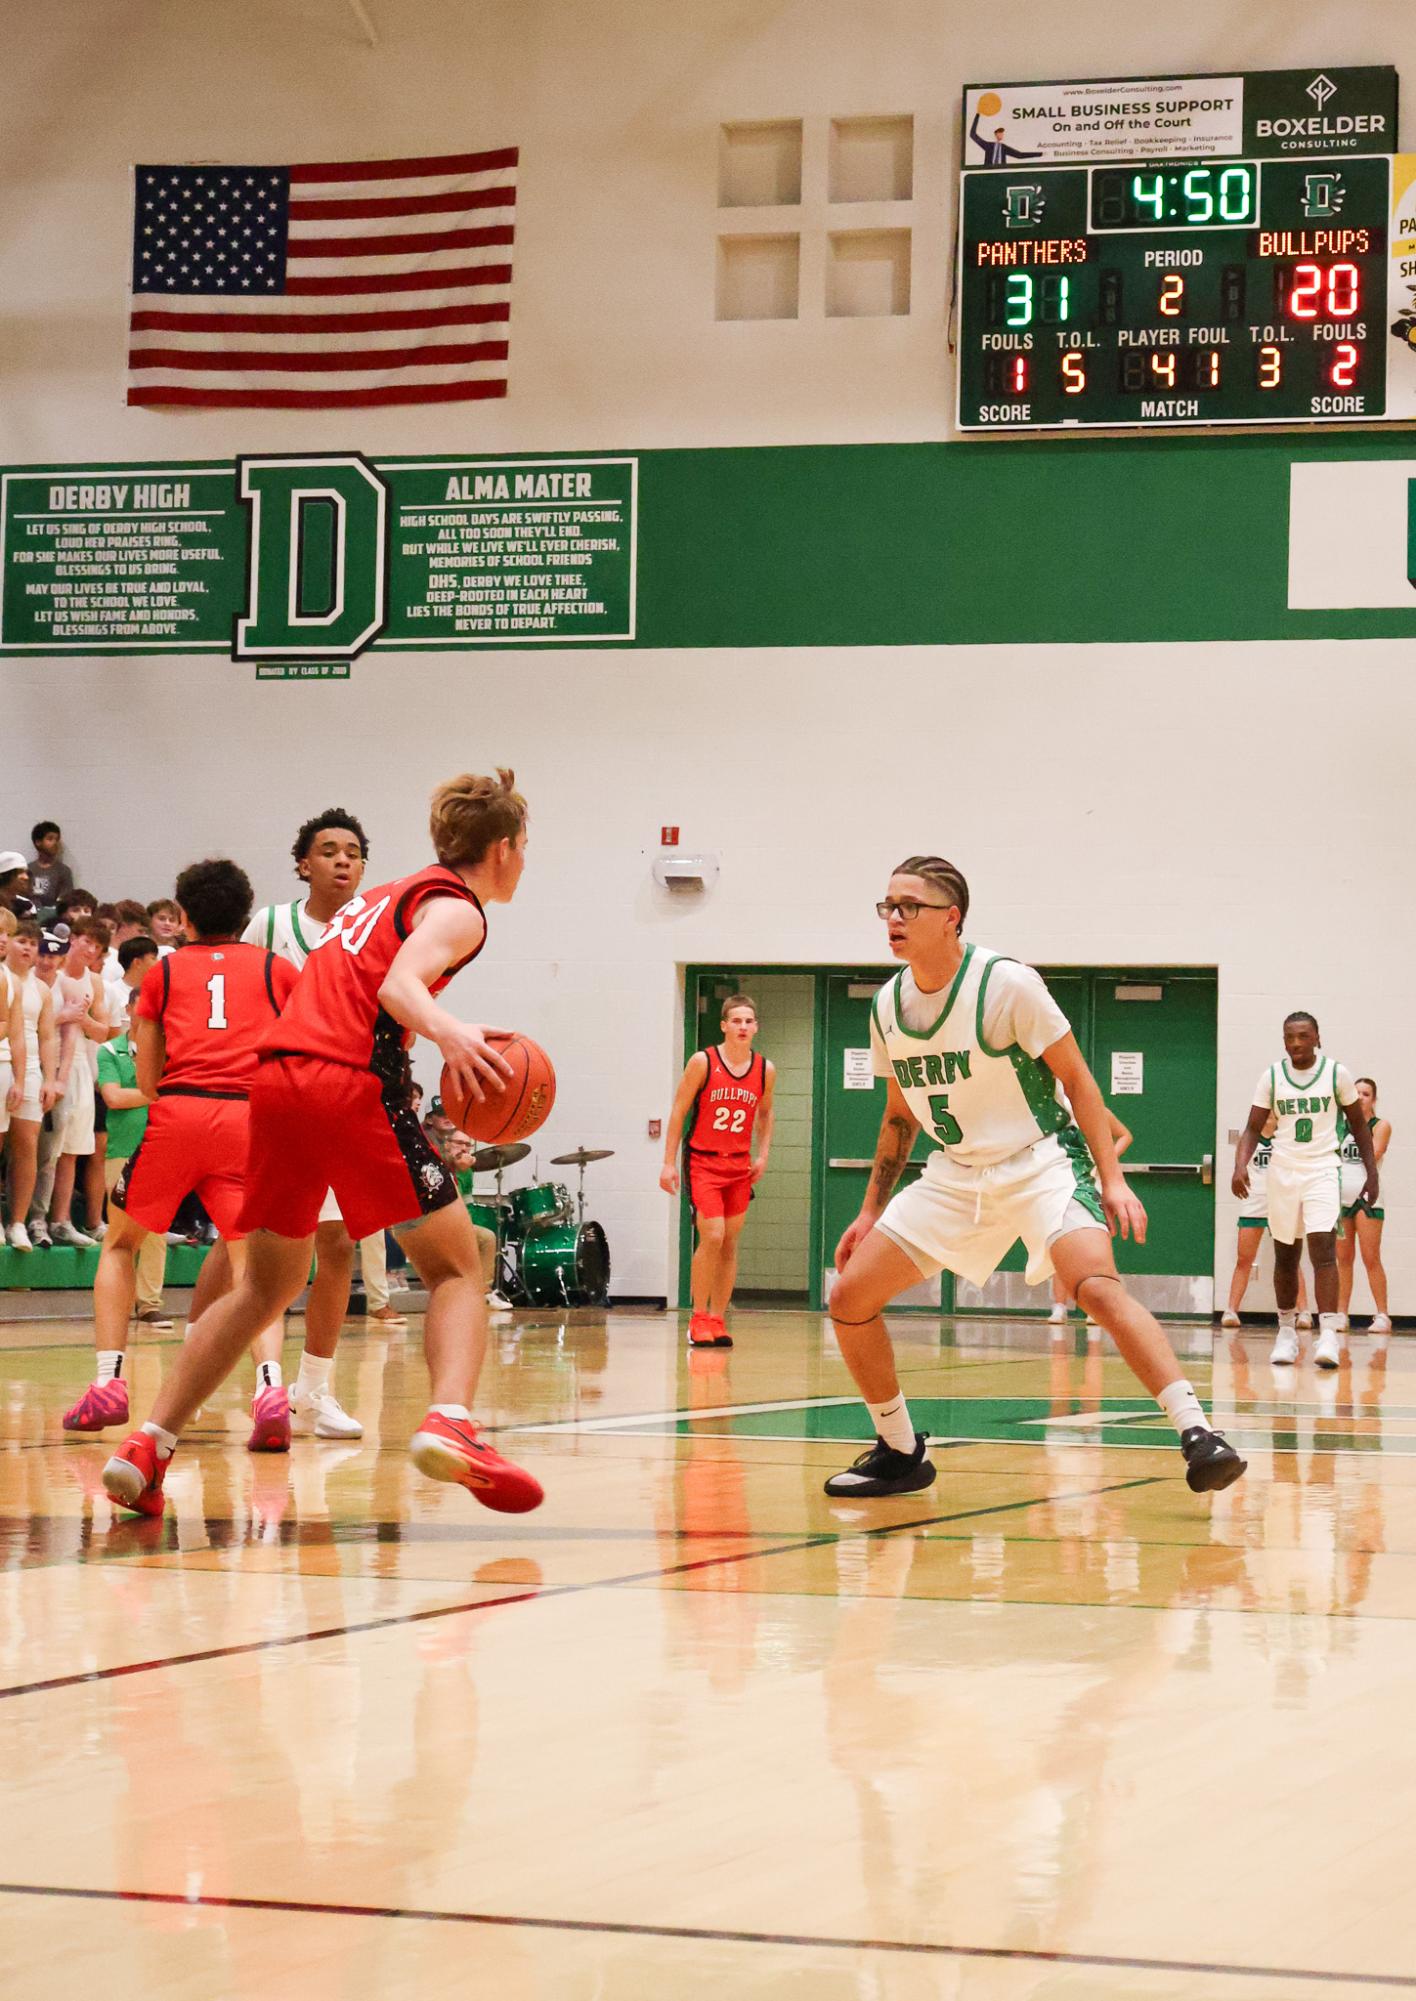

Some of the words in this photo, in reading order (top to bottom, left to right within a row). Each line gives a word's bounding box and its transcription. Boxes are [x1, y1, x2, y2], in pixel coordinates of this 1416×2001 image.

[1012, 106, 1066, 120] SMALL
[1071, 102, 1151, 117] BUSINESS
[1155, 98, 1234, 113] SUPPORT
[1052, 122, 1071, 132] On
[1075, 120, 1100, 131] and
[1104, 120, 1125, 130] Off
[1128, 119, 1150, 129] the
[1154, 117, 1191, 128] Court
[1256, 114, 1386, 137] BOXELDER
[1281, 139, 1357, 149] CONSULTING
[1133, 168, 1250, 222] 4:50
[1259, 229, 1369, 256] BULLPUPS
[978, 239, 1086, 266] PANTHERS
[1144, 250, 1203, 267] PERIOD
[1159, 275, 1184, 315] 2
[1291, 264, 1358, 317] 20
[1057, 331, 1101, 348] T.O.L.
[1118, 329, 1180, 347] PLAYER
[1188, 327, 1230, 345] FOUL
[1250, 326, 1295, 343] T.O.L.
[1312, 323, 1367, 340] FOULS
[981, 333, 1033, 351] FOULS
[1014, 358, 1024, 391] 1
[1062, 353, 1085, 394] 5
[1260, 347, 1281, 388] 3
[1332, 345, 1357, 386] 2
[979, 405, 1031, 423] SCORE
[1141, 400, 1199, 418] MATCH
[1311, 396, 1365, 414] SCORE
[445, 475, 510, 501] ALMA
[515, 472, 592, 499] MATER
[49, 485, 128, 510] DERBY
[133, 483, 190, 509] HIGH
[400, 515, 426, 527] HIGH
[427, 514, 469, 526] SCHOOL
[471, 513, 500, 525] DAYS
[501, 512, 523, 524] ARE
[525, 511, 571, 524] SWIFTLY
[26, 524, 45, 535] LET
[46, 524, 61, 535] US
[62, 523, 87, 534] SING
[88, 523, 101, 534] OF
[103, 523, 139, 534] DERBY
[140, 522, 167, 533] HIGH
[438, 528, 457, 540] ALL
[459, 528, 481, 539] TOO
[483, 527, 513, 539] SOON
[514, 526, 556, 538] THEY'LL
[55, 537, 83, 549] LOUD
[84, 537, 106, 548] HER
[107, 536, 151, 547] PRAISES
[402, 543, 424, 555] BUT
[425, 542, 459, 554] WHILE
[462, 542, 479, 553] WE
[481, 541, 504, 553] LIVE
[506, 540, 538, 552] WE'LL
[540, 539, 568, 551] EVER
[13, 552, 34, 563] FOR
[35, 551, 56, 562] SHE
[57, 551, 93, 562] MAKES
[94, 550, 117, 561] OUR
[119, 550, 148, 561] LIVES
[149, 549, 179, 560] MORE
[234, 455, 387, 658] D
[429, 555, 485, 568] MEMORIES
[486, 555, 500, 566] OF
[502, 554, 544, 566] SCHOOL
[546, 553, 592, 566] FRIENDS
[55, 564, 111, 576] BLESSINGS
[113, 564, 127, 575] TO
[128, 564, 142, 575] US
[25, 583, 48, 594] MAY
[50, 583, 72, 594] OUR
[74, 583, 103, 594] LIVES
[105, 582, 119, 594] BE
[121, 582, 147, 593] TRUE
[149, 582, 171, 593] AND
[463, 575, 501, 587] DERBY
[503, 575, 521, 586] WE
[523, 574, 552, 586] LOVE
[54, 597, 68, 608] TO
[68, 597, 88, 608] THE
[90, 596, 130, 607] SCHOOL
[132, 596, 149, 607] WE
[426, 589, 505, 602] DEEP-ROOTED
[506, 589, 518, 601] IN
[520, 588, 549, 600] EACH
[551, 588, 588, 600] HEART
[34, 611, 53, 622] LET
[54, 611, 68, 622] US
[70, 611, 98, 622] WISH
[100, 610, 127, 621] FAME
[129, 610, 151, 621] AND
[407, 605, 430, 618] LIES
[433, 604, 453, 616] THE
[455, 604, 494, 616] BONDS
[495, 603, 510, 615] OF
[513, 603, 541, 615] TRUE
[52, 624, 108, 636] BLESSINGS
[110, 624, 140, 635] FROM
[455, 618, 492, 630] NEVER
[494, 618, 509, 629] TO
[207, 974, 228, 1029] 1
[892, 1050, 972, 1088] DERBY
[1276, 1096, 1332, 1115] DERBY
[713, 1107, 746, 1133] 22
[928, 1094, 964, 1145] 5
[1295, 1118, 1313, 1142] 0
